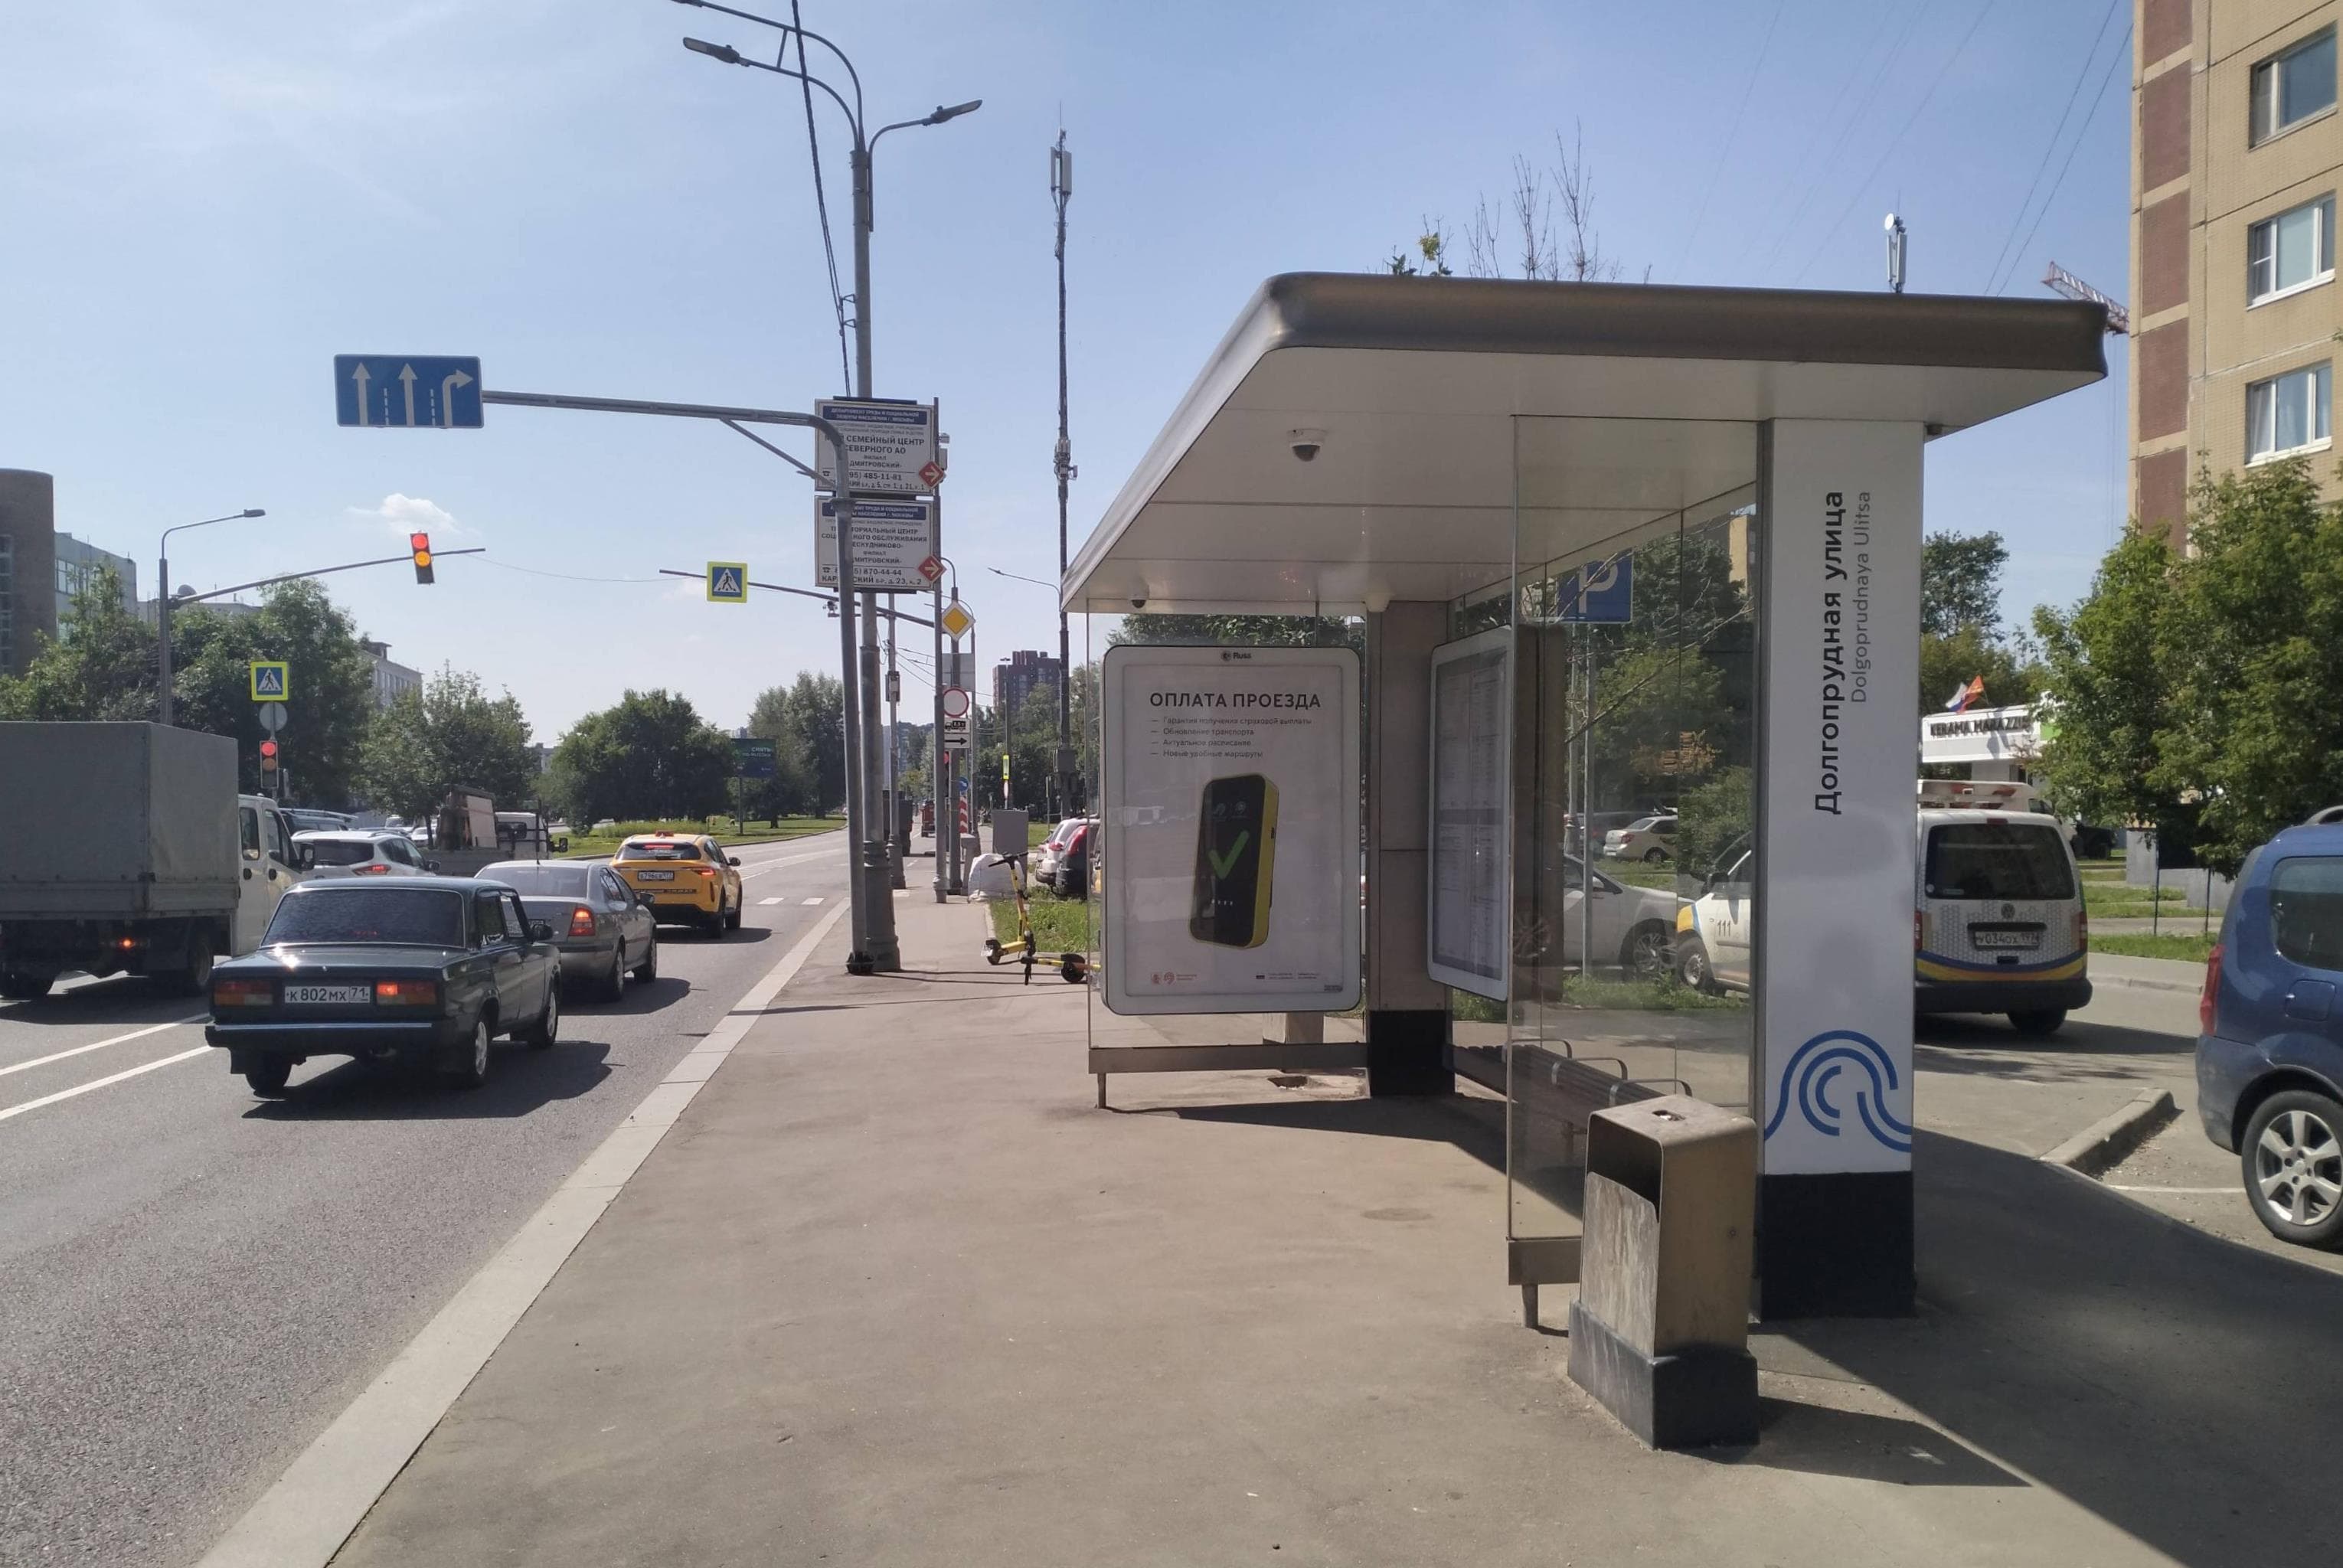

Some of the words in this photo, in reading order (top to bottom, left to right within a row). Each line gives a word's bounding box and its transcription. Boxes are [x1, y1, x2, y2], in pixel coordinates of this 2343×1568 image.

[846, 435, 896, 444] СЕМЕЙНЫЙ
[897, 438, 925, 446] ЦЕНТР
[1854, 492, 1871, 547] Ulitsa
[1825, 492, 1848, 581] улица
[1851, 551, 1872, 703] Dolgoprudnaya
[1150, 691, 1227, 708] ОПЛАТА
[1233, 693, 1322, 710] ПРОЕЗДА
[1815, 593, 1845, 815] Долгопрудная
[1163, 717, 1198, 725] Гарантия
[1240, 717, 1278, 725] страховой
[1930, 720, 1972, 736] KERAMA
[1163, 739, 1207, 747] Актуальное
[1189, 750, 1223, 759] удобные
[1717, 920, 1731, 938] 111
